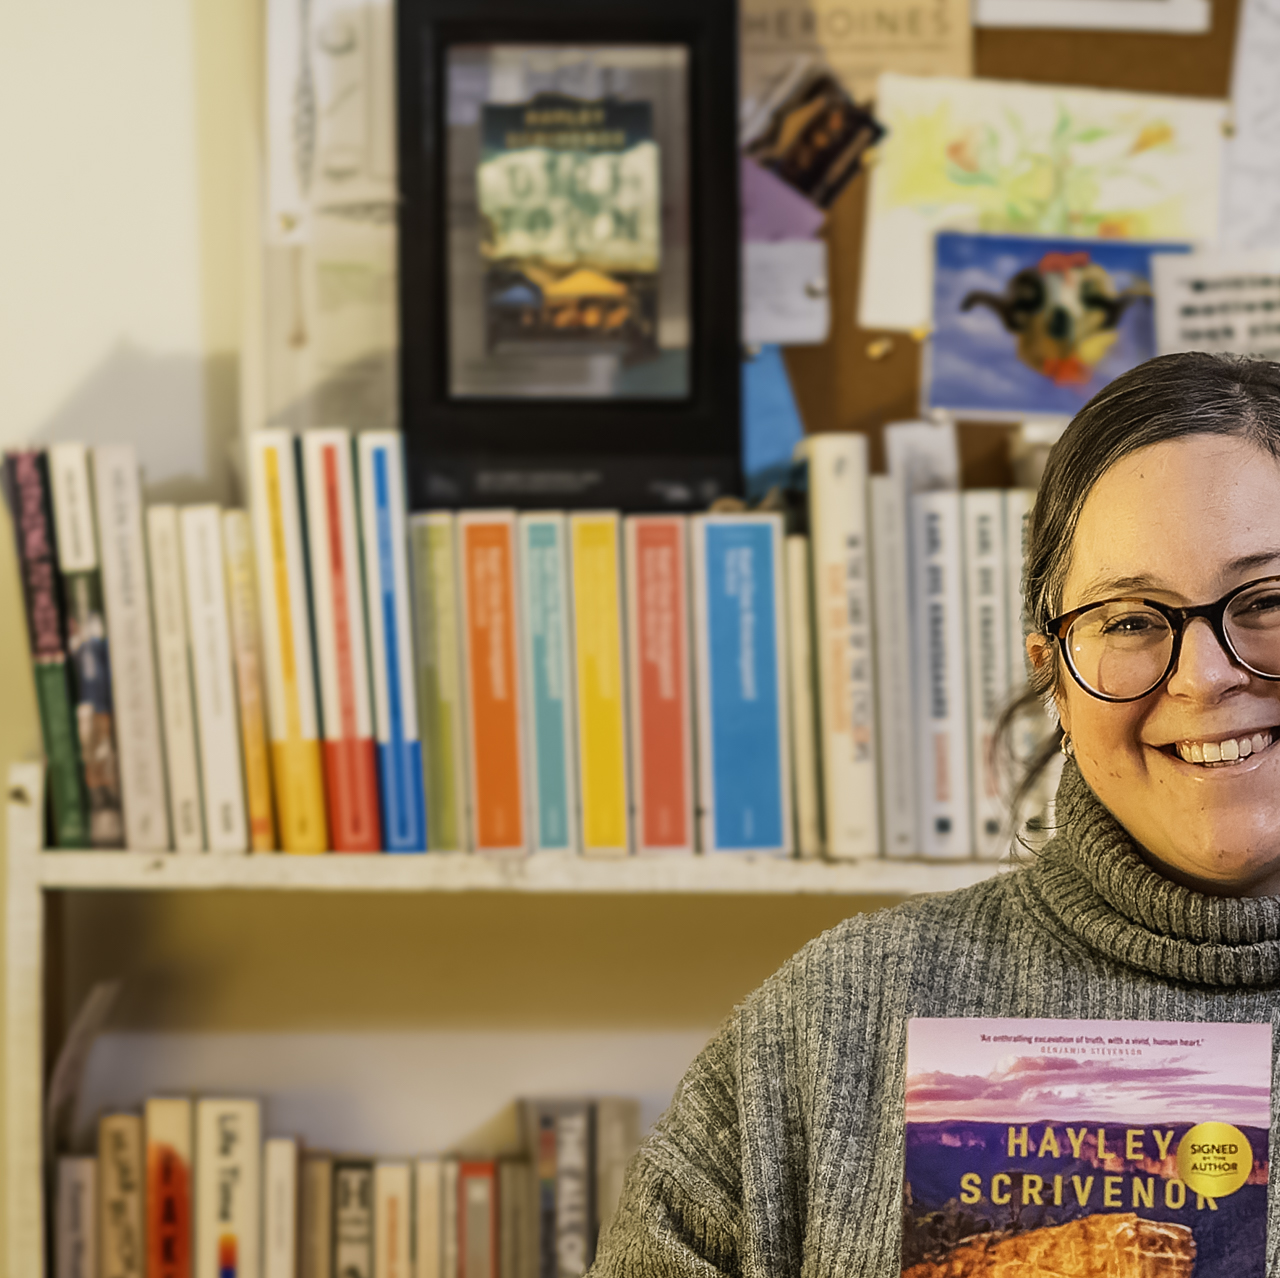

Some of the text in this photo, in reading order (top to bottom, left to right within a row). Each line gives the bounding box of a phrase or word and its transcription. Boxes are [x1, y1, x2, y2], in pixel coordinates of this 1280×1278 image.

[993, 1034, 1031, 1045] enthralling
[1034, 1036, 1074, 1045] excavation
[1075, 1036, 1083, 1045] of
[1084, 1036, 1105, 1047] truth,
[1108, 1037, 1123, 1047] with
[1153, 1038, 1177, 1048] human
[1007, 1126, 1175, 1160] HAYLEY
[1190, 1144, 1238, 1154] SIGNED
[1191, 1162, 1237, 1171] AUTHOR
[217, 1164, 241, 1223] Time
